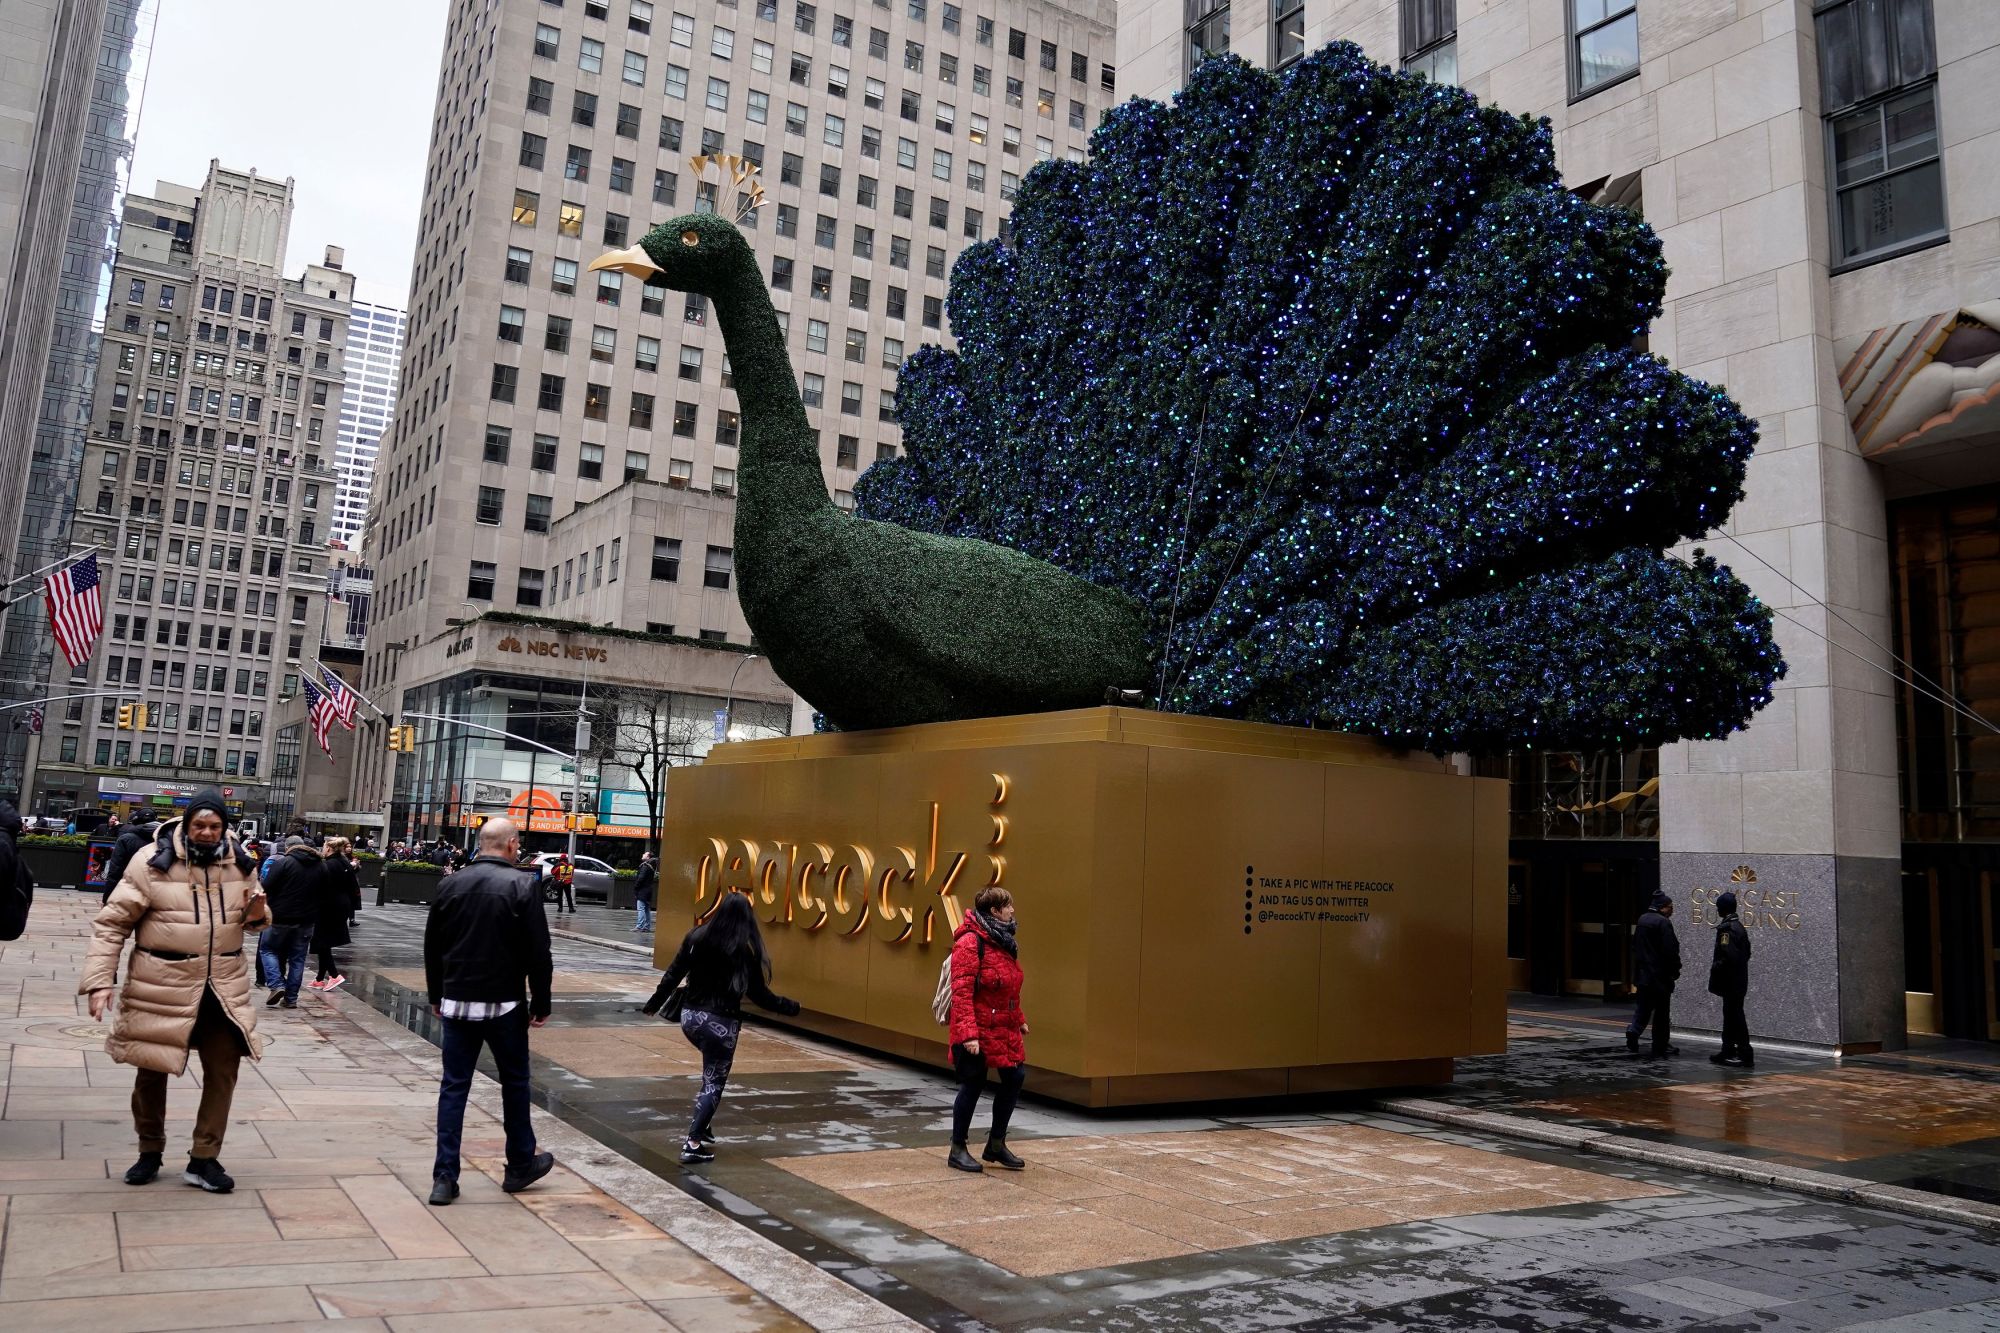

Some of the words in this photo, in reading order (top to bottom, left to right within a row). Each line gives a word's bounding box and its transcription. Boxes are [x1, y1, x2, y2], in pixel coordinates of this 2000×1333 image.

[527, 640, 560, 658] NBC
[564, 643, 608, 663] NEWS
[536, 822, 551, 830] AND
[694, 800, 968, 946] peacock
[1260, 878, 1283, 889] TAKE
[1284, 879, 1292, 889] A
[1293, 880, 1309, 889] PIC
[1310, 880, 1333, 890] WITH
[1336, 881, 1352, 891] THE
[1354, 881, 1394, 892] PEACOCK
[1259, 895, 1279, 905] AND
[1281, 896, 1299, 906] TAG
[1301, 896, 1313, 906] US
[1315, 896, 1330, 907] ON
[1331, 897, 1369, 907] TWITTER
[1692, 888, 1799, 909] COCAST
[1258, 910, 1316, 923] @PeacockTV
[1317, 911, 1370, 922] #PeacockTV
[1692, 908, 1801, 931] BUDING
